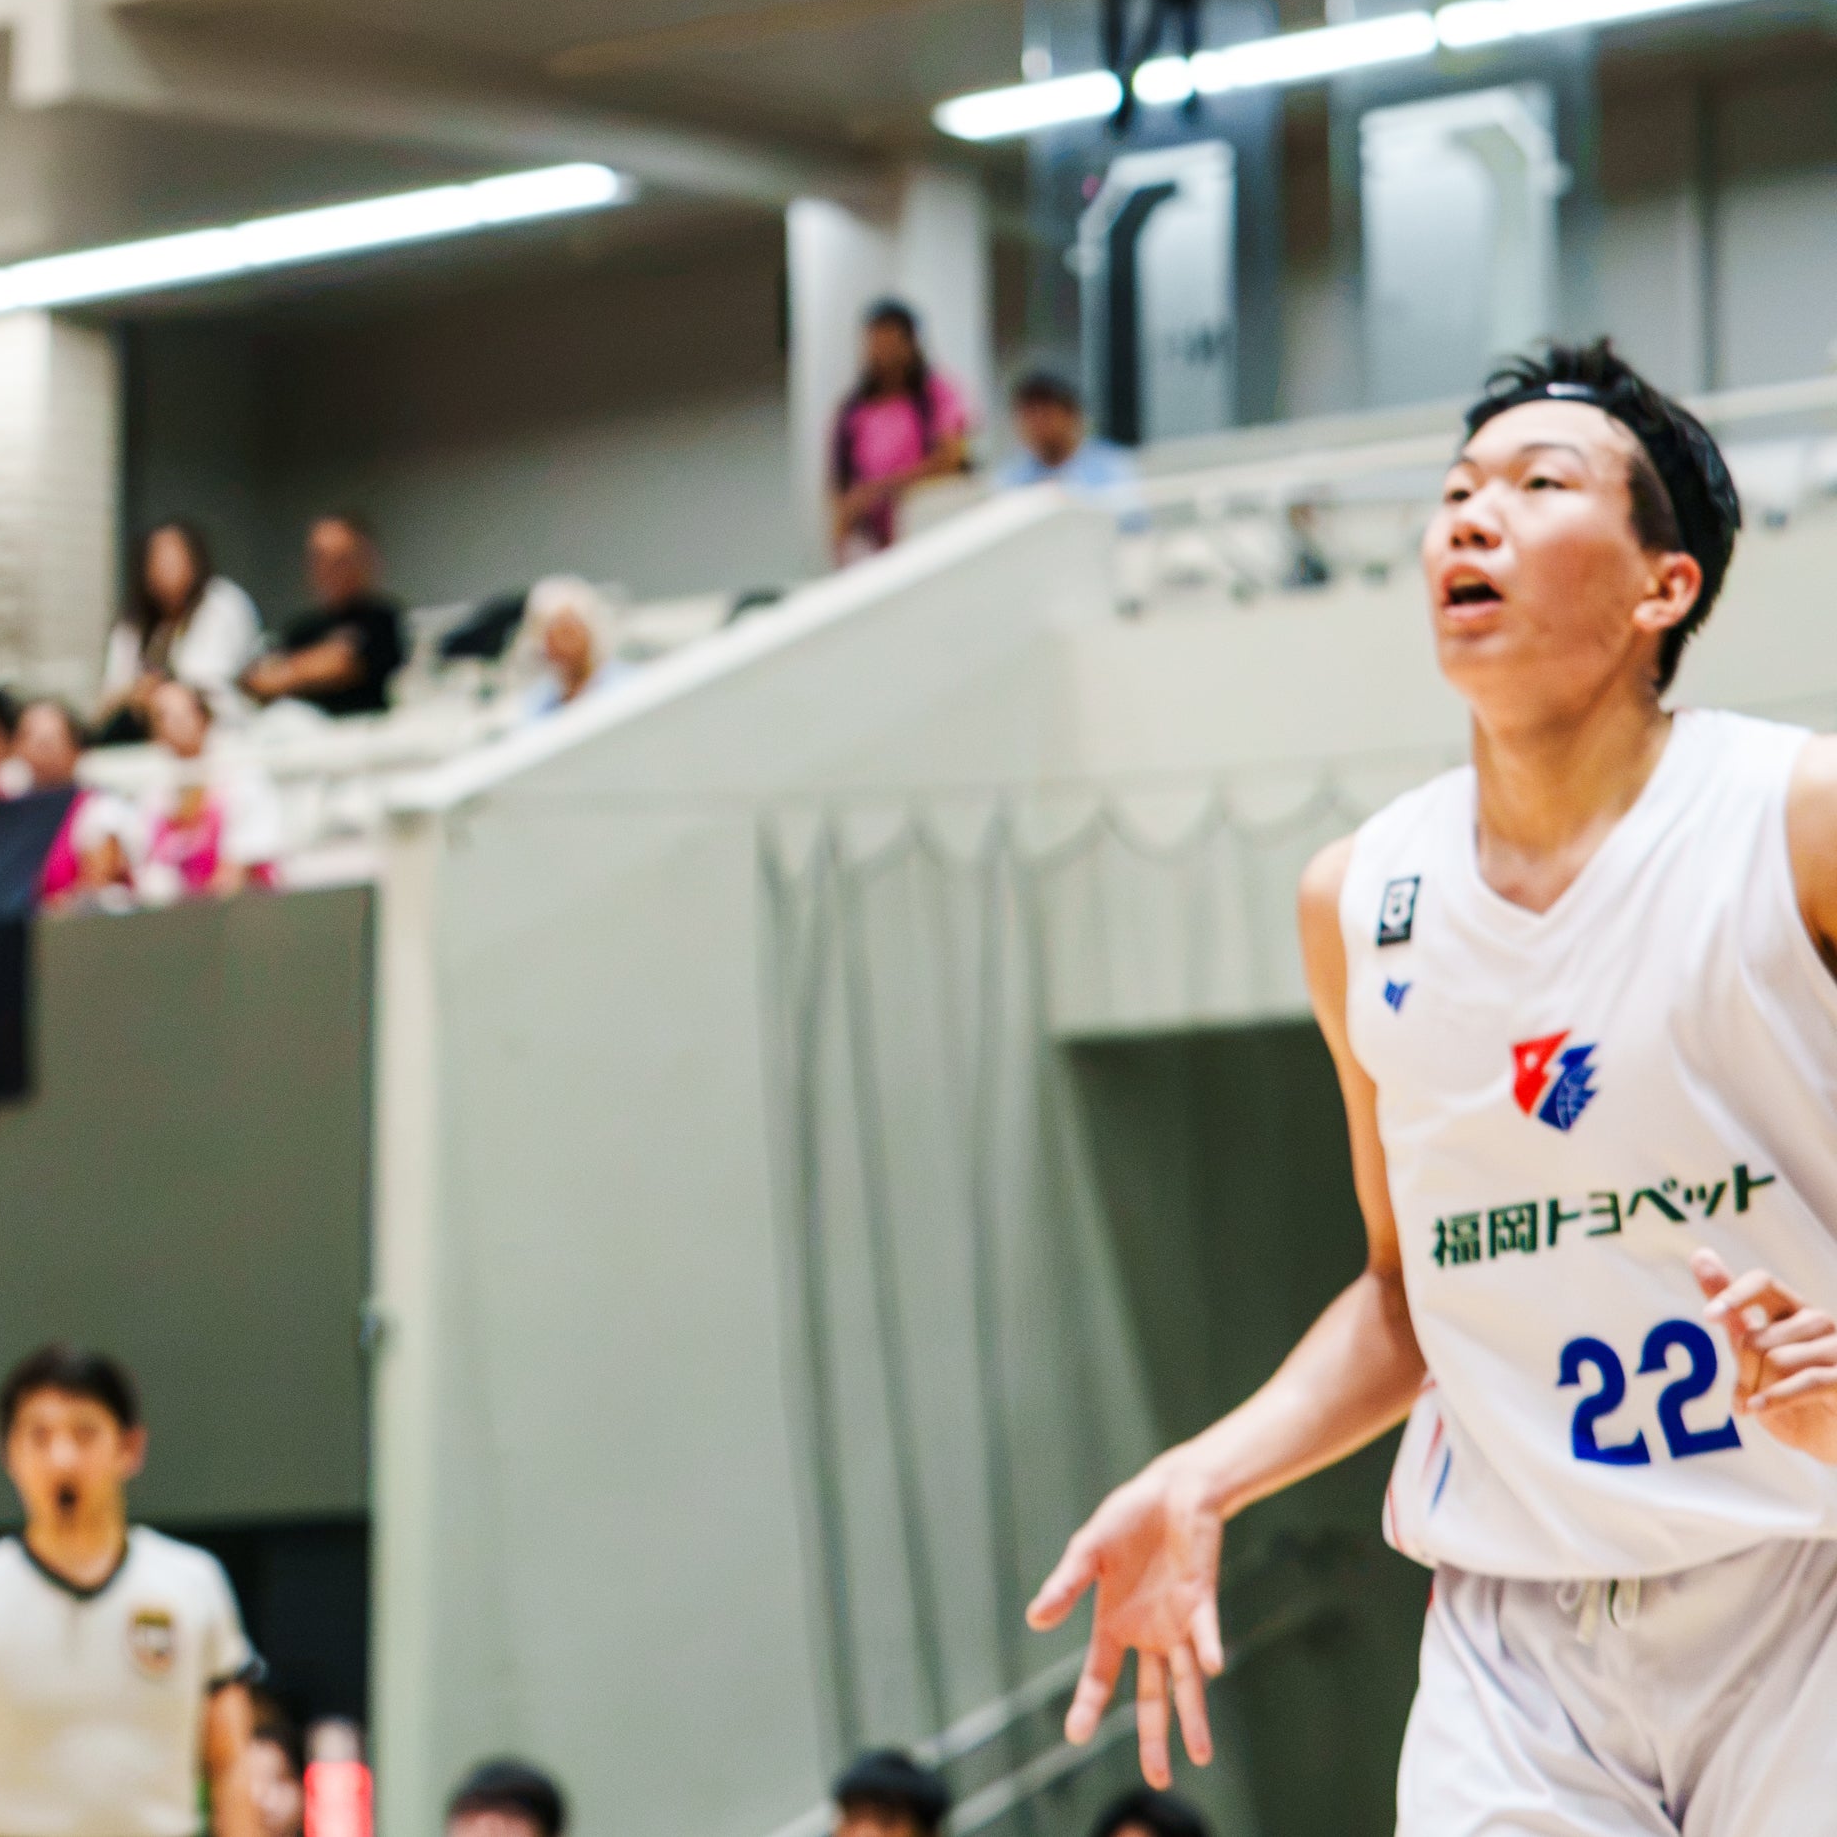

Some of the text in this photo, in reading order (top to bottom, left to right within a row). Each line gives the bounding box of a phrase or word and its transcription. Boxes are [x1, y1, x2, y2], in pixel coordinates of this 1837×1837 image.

[1431, 1163, 1776, 1268] 福岡トヨペット
[1555, 1319, 1743, 1466] 22
